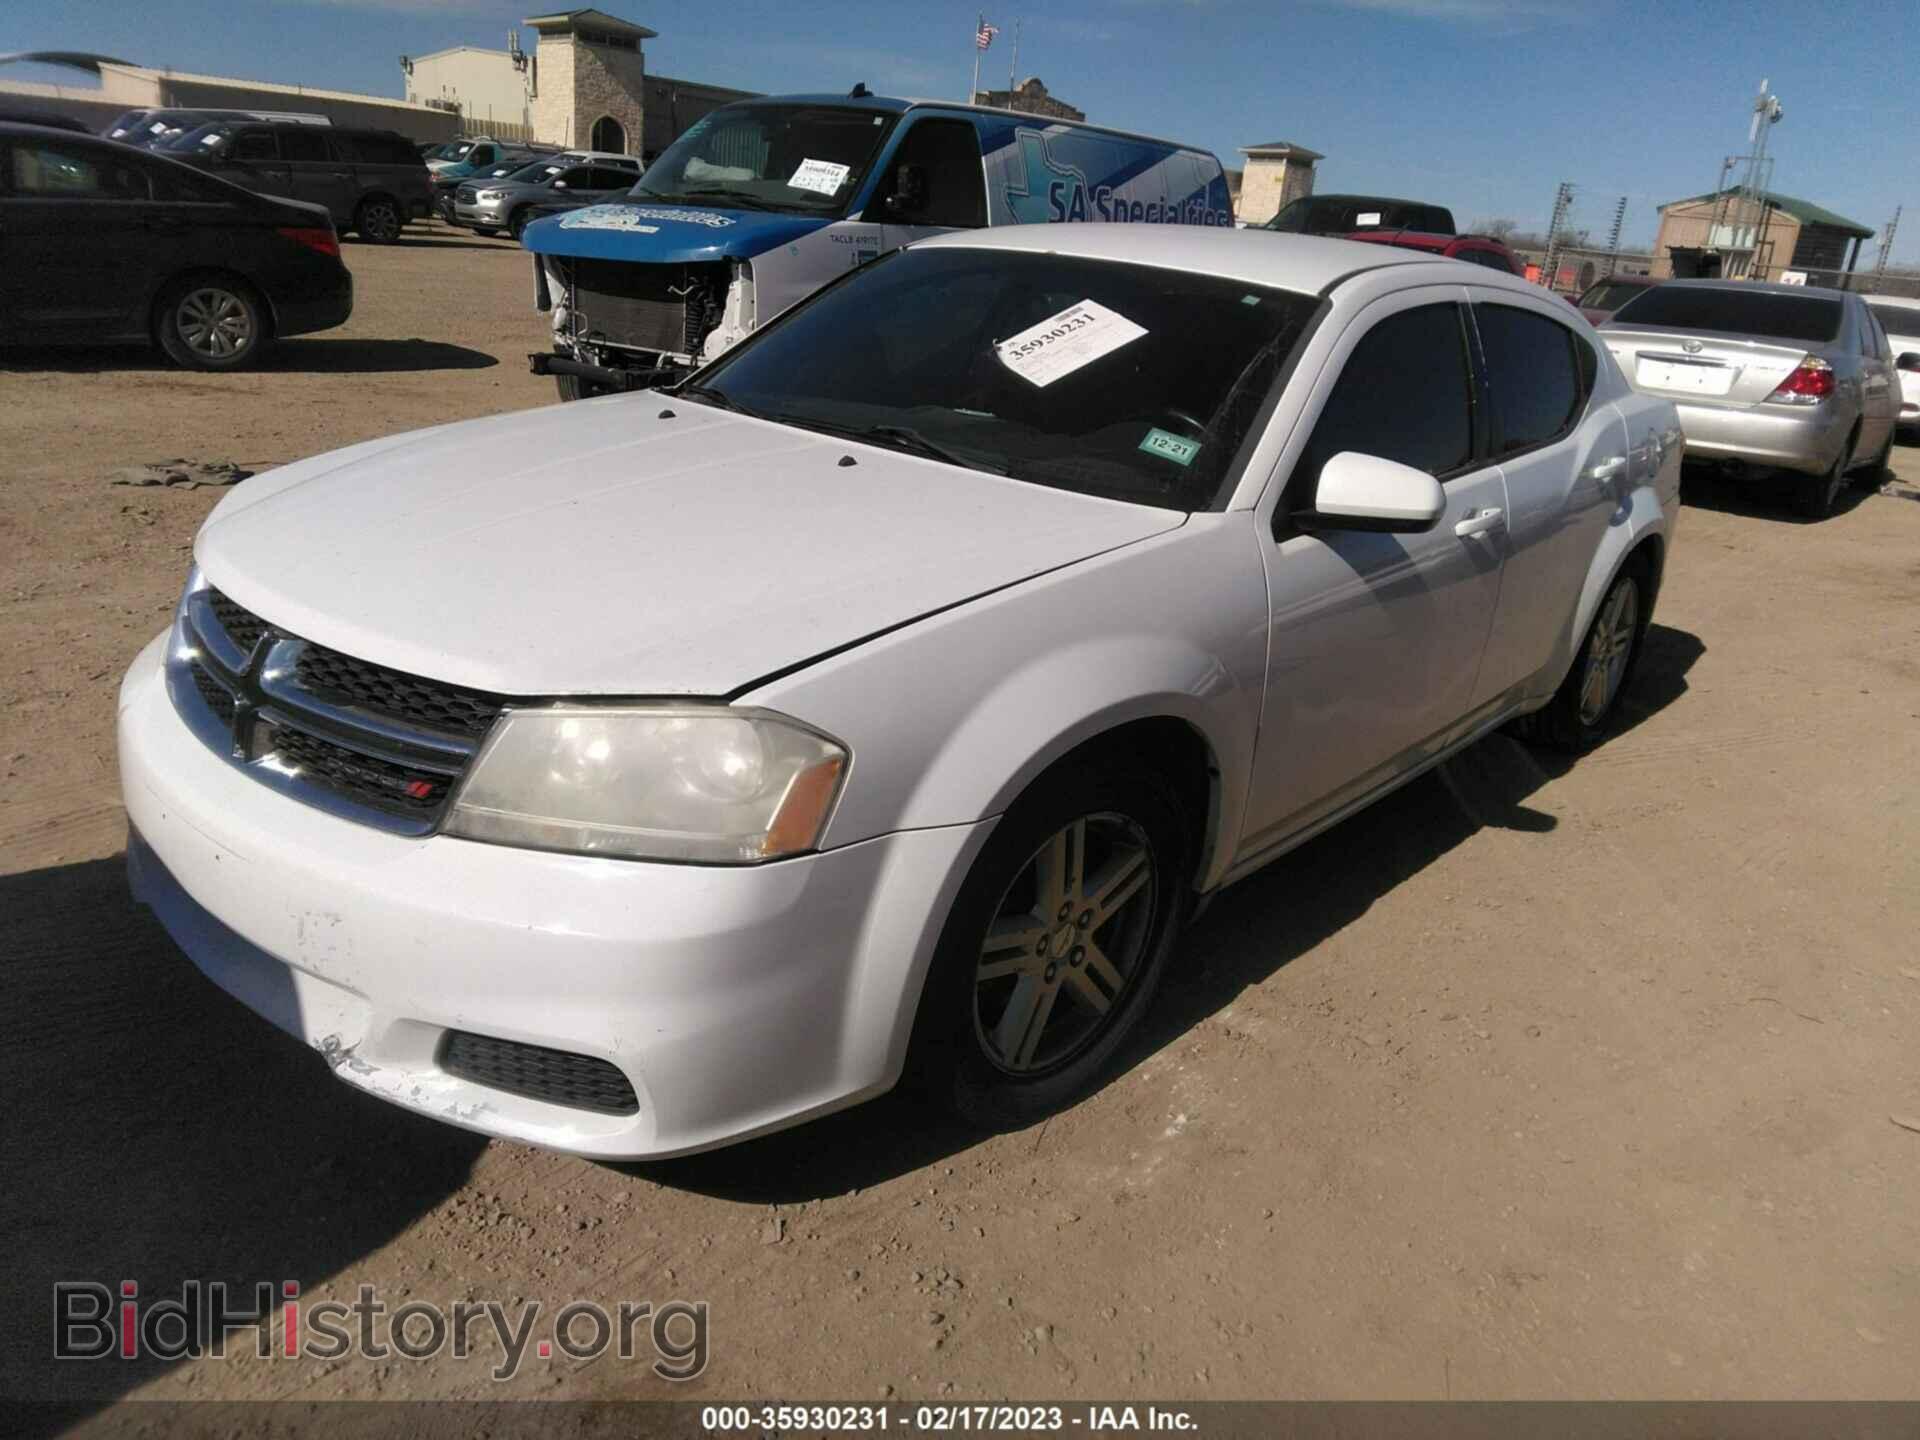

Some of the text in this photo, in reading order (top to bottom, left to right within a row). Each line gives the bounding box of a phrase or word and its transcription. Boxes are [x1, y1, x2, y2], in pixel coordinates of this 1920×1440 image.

[1049, 182, 1087, 223] SA
[1009, 312, 1096, 361] 35930231
[1152, 437, 1188, 456] 12-21
